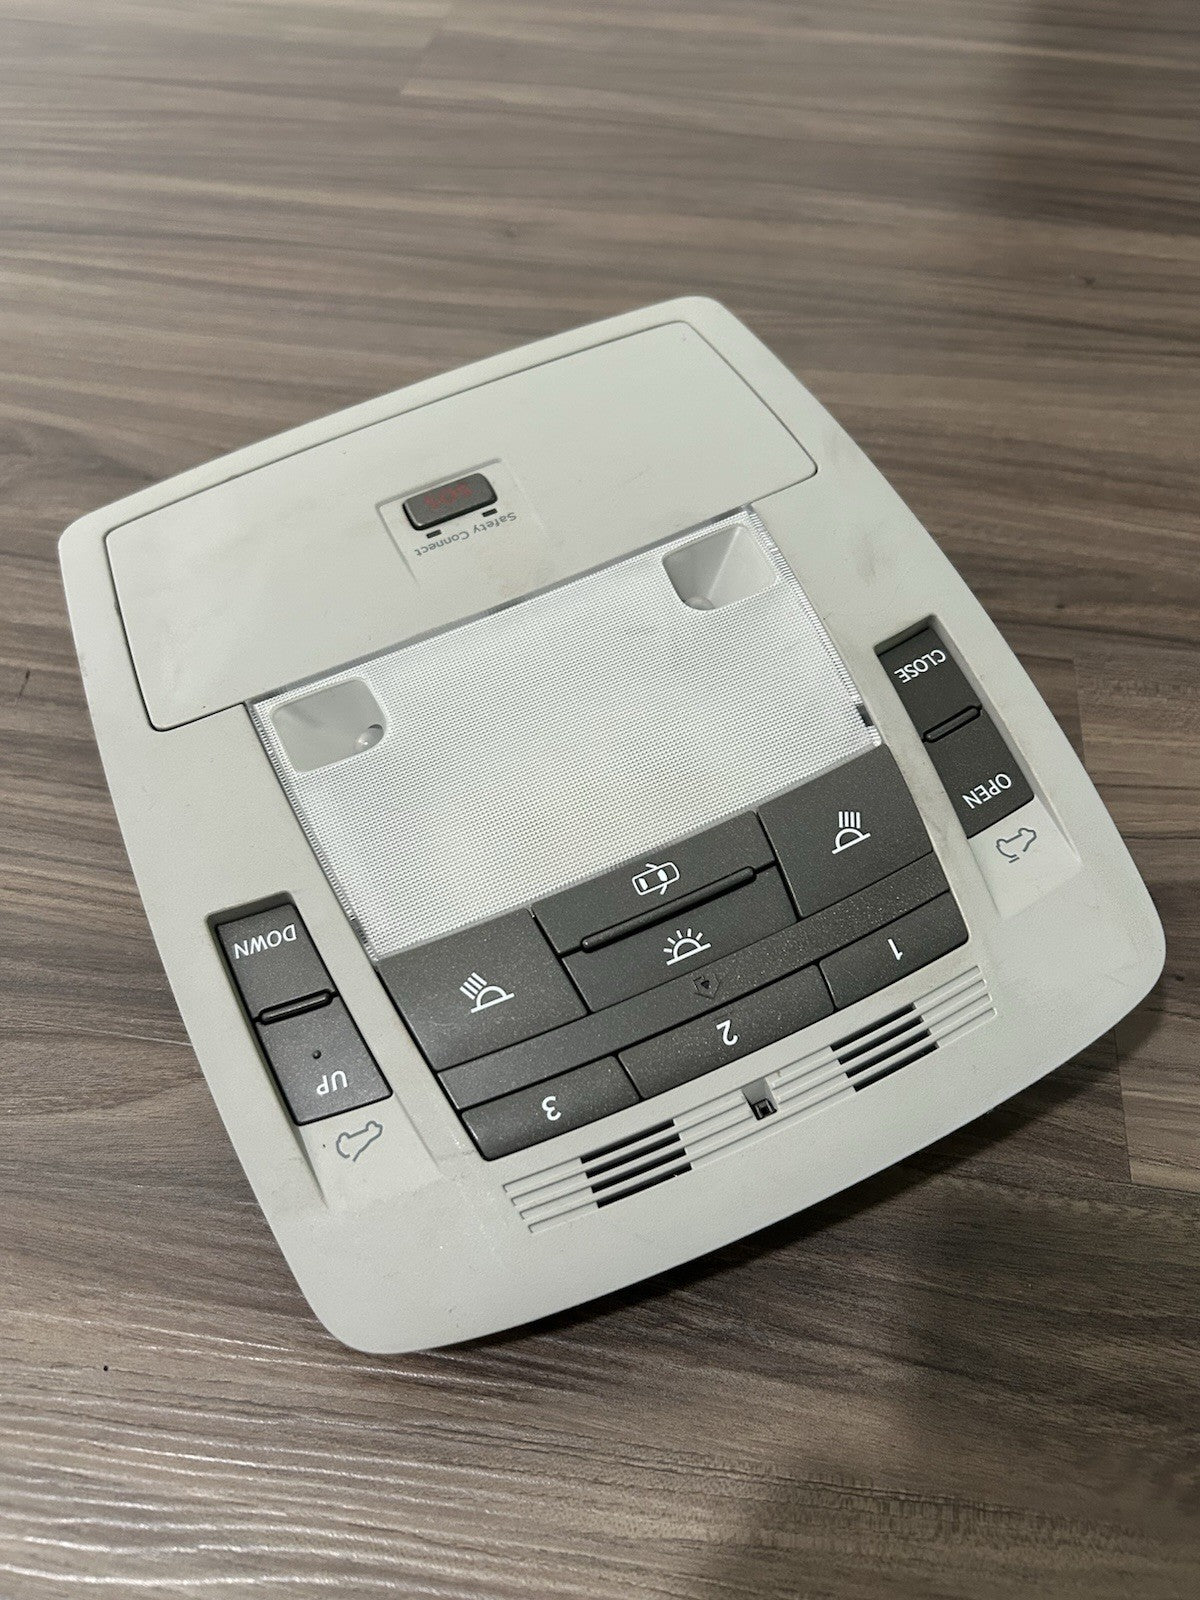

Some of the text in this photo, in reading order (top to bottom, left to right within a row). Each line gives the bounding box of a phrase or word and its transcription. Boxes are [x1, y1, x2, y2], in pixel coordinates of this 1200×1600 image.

[414, 512, 517, 556] Safety Connect
[894, 649, 946, 683] CLOSE
[962, 773, 1012, 809] OPEN
[233, 924, 297, 959] DOWN
[887, 938, 903, 960] 1
[716, 1019, 739, 1046] 2
[316, 1070, 348, 1095] UP
[541, 1095, 561, 1121] 3
